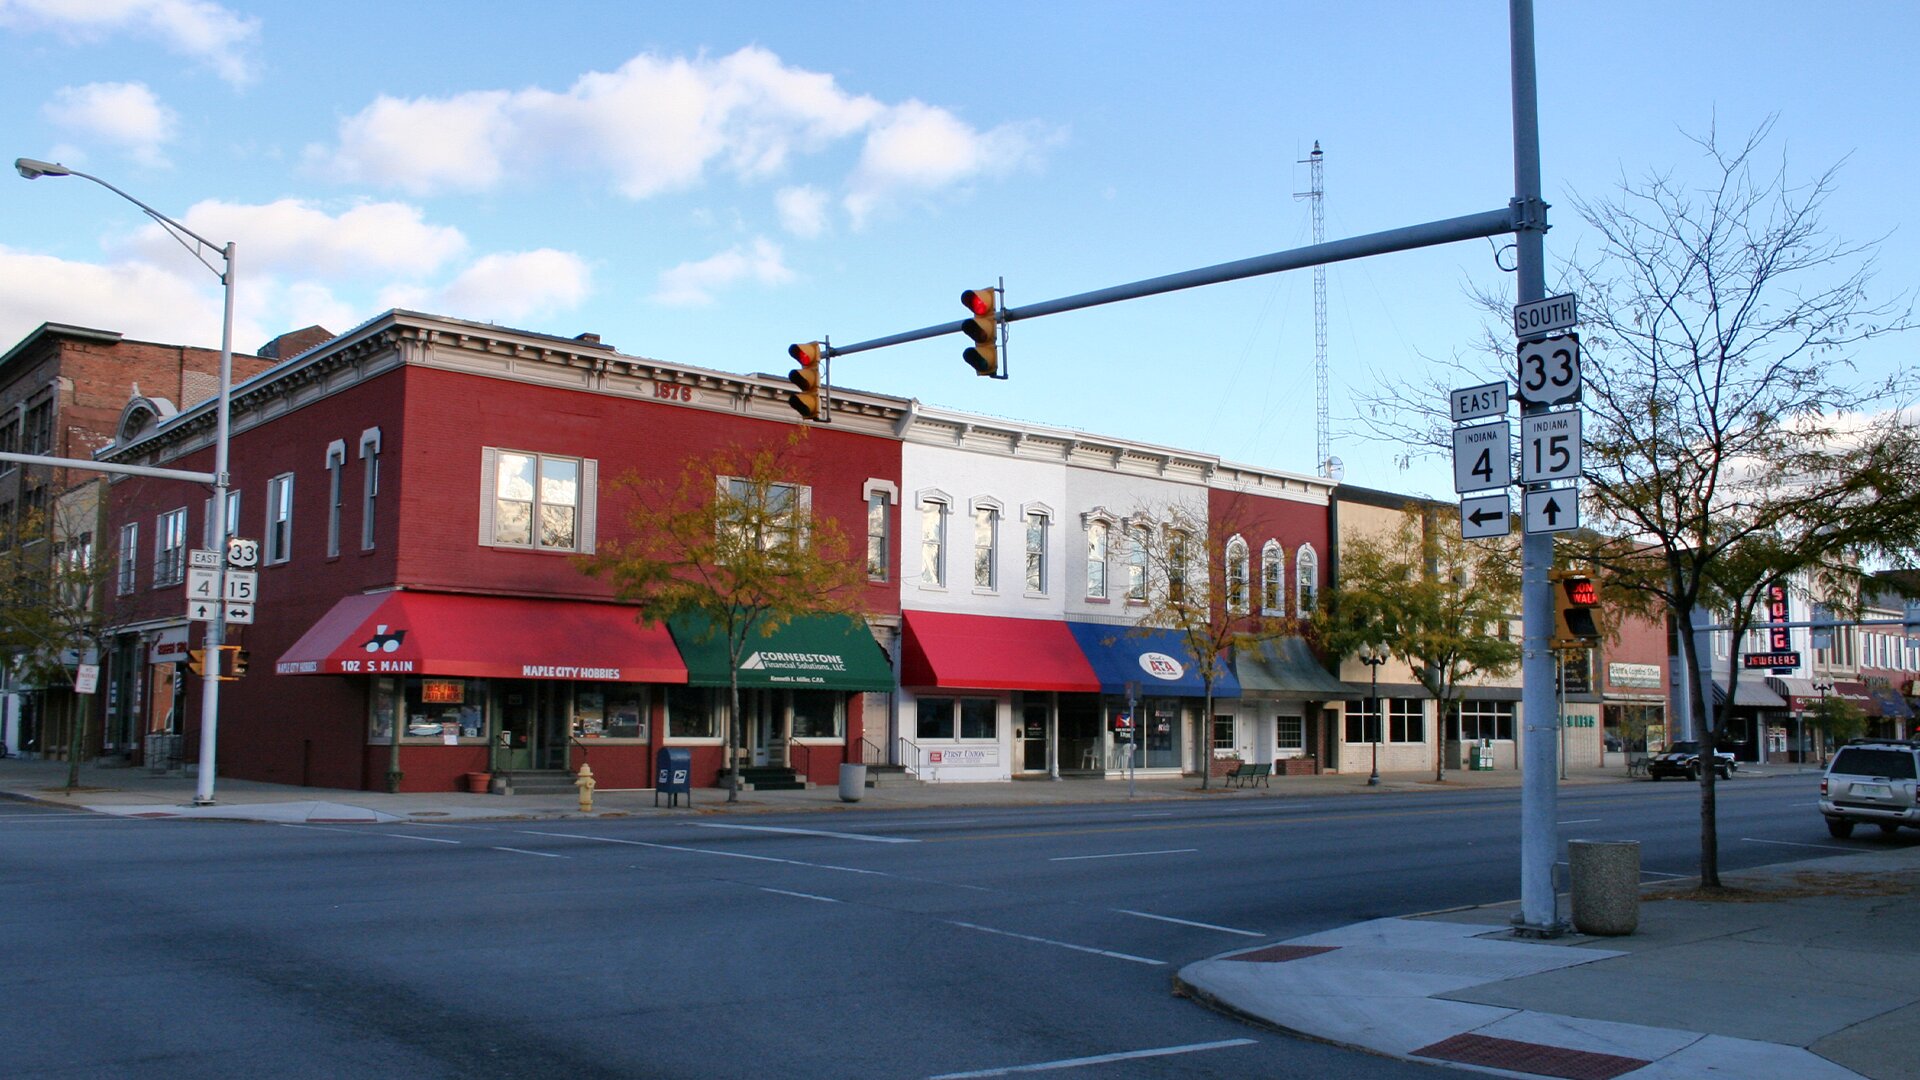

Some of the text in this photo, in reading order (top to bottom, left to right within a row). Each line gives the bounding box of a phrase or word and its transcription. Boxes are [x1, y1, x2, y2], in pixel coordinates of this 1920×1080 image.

[1518, 301, 1572, 330] SOUTH
[1525, 349, 1573, 391] 33
[1460, 390, 1499, 414] EAST
[1533, 419, 1568, 433] INDIANA
[1465, 430, 1498, 444] INDIANA
[1533, 435, 1571, 474] 15
[1471, 447, 1493, 483] 4
[195, 553, 218, 564] EAST
[231, 544, 255, 562] 33
[197, 580, 210, 596] 4
[230, 581, 251, 598] 15
[760, 651, 844, 664] CORNERSTONE
[1748, 656, 1796, 666] JEWELERS
[341, 660, 413, 672] 102 S. MAIN
[523, 665, 620, 680] MAPLE CITY HOBBIES
[764, 661, 847, 672] Financial Solutions, LLC
[943, 749, 962, 758] FIRST
[964, 749, 985, 758] UNION
